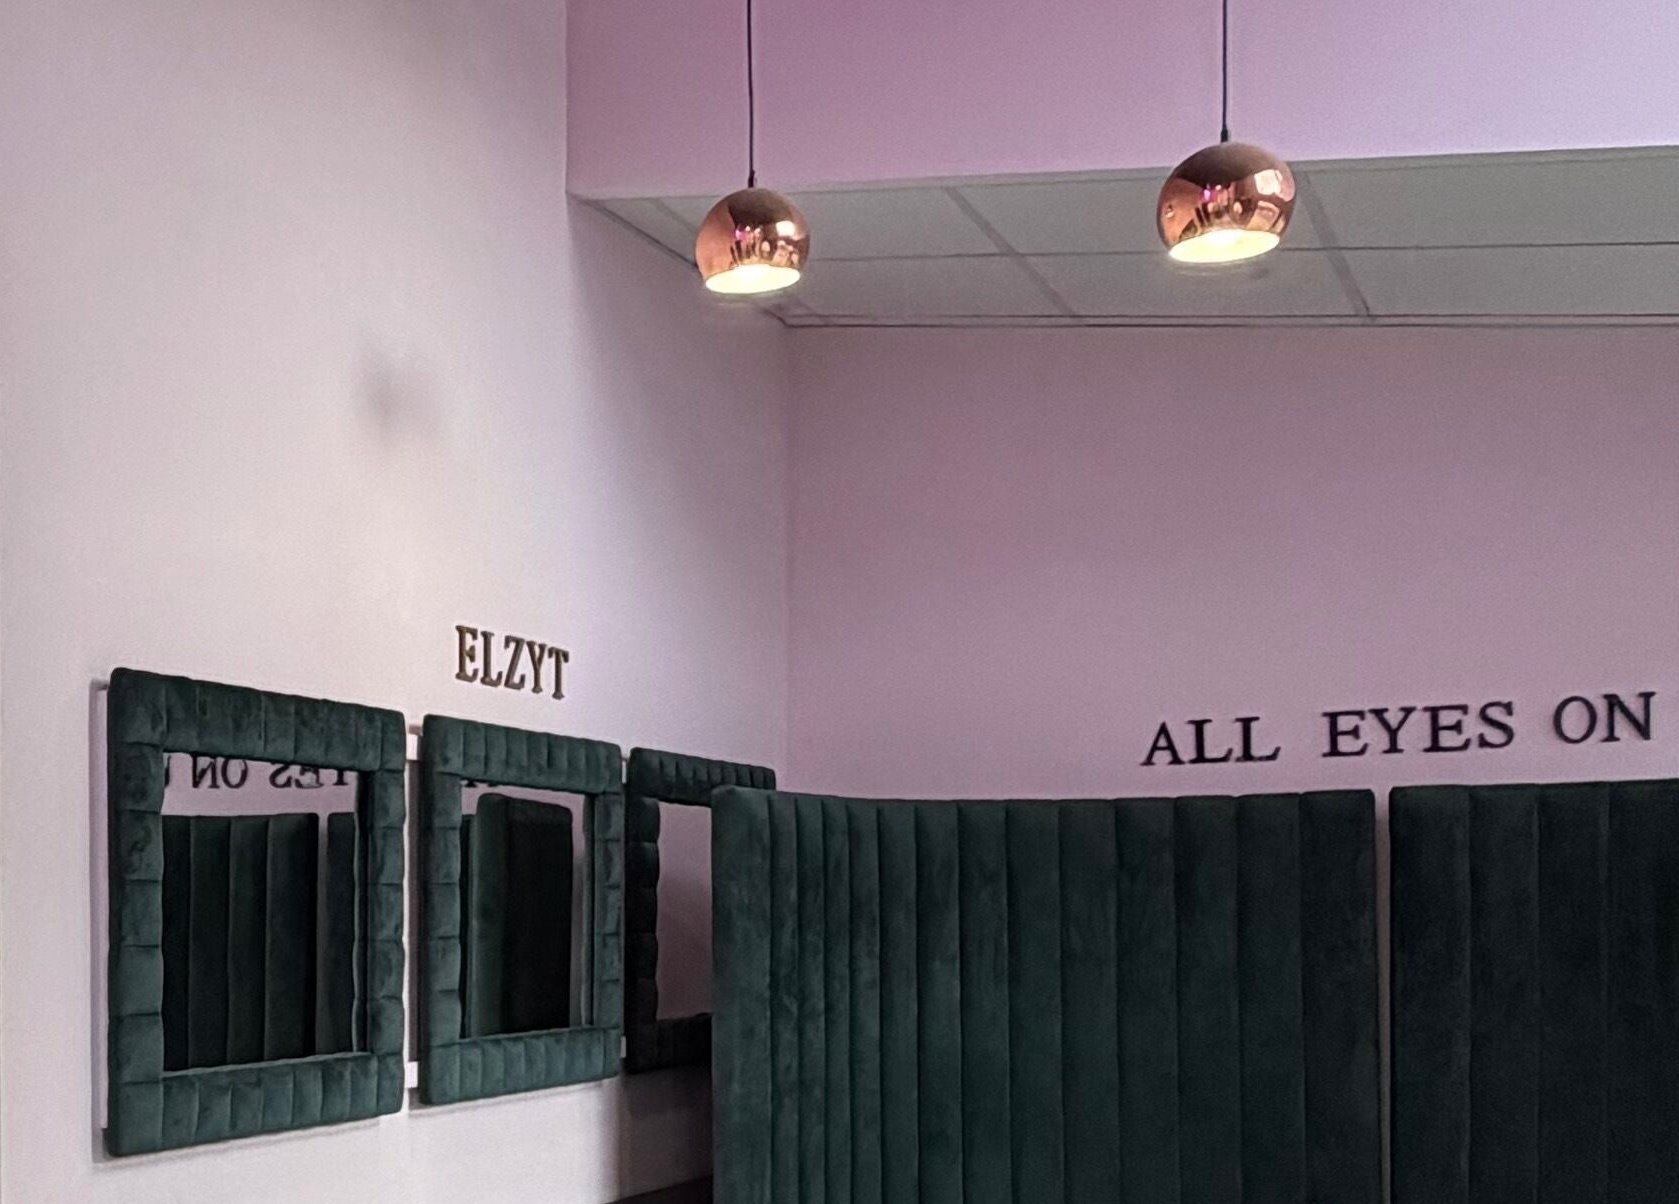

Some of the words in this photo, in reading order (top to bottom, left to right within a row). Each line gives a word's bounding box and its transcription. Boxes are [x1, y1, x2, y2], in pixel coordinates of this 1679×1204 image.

[455, 625, 569, 700] ELZYT
[1140, 716, 1281, 765] ALL
[1321, 700, 1515, 757] EYES
[1552, 691, 1657, 744] ON
